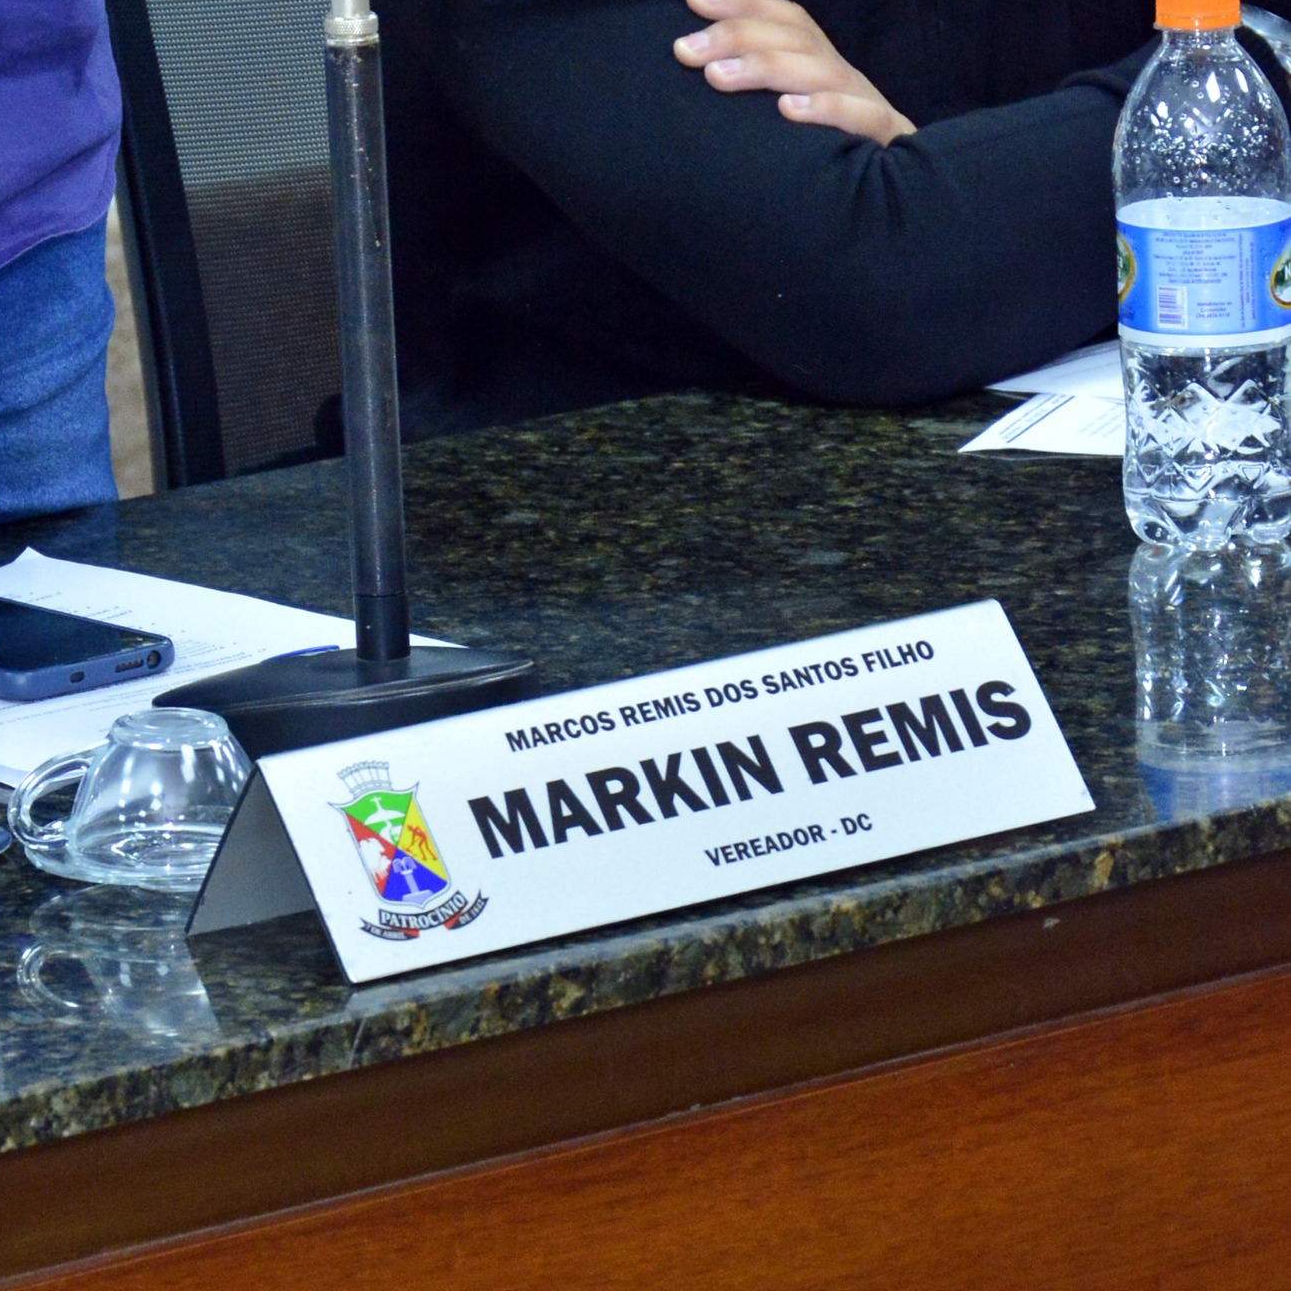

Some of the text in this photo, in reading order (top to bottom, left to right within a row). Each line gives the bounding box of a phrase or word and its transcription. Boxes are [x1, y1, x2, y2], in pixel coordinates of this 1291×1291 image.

[505, 640, 934, 752] MARCOS REMIS DOS SANTOS FILHO
[467, 680, 1032, 859] MARKIN REMIS
[704, 824, 827, 867] VEREADOR
[840, 813, 873, 836] DC
[381, 894, 466, 928] PATROCÍNIO
